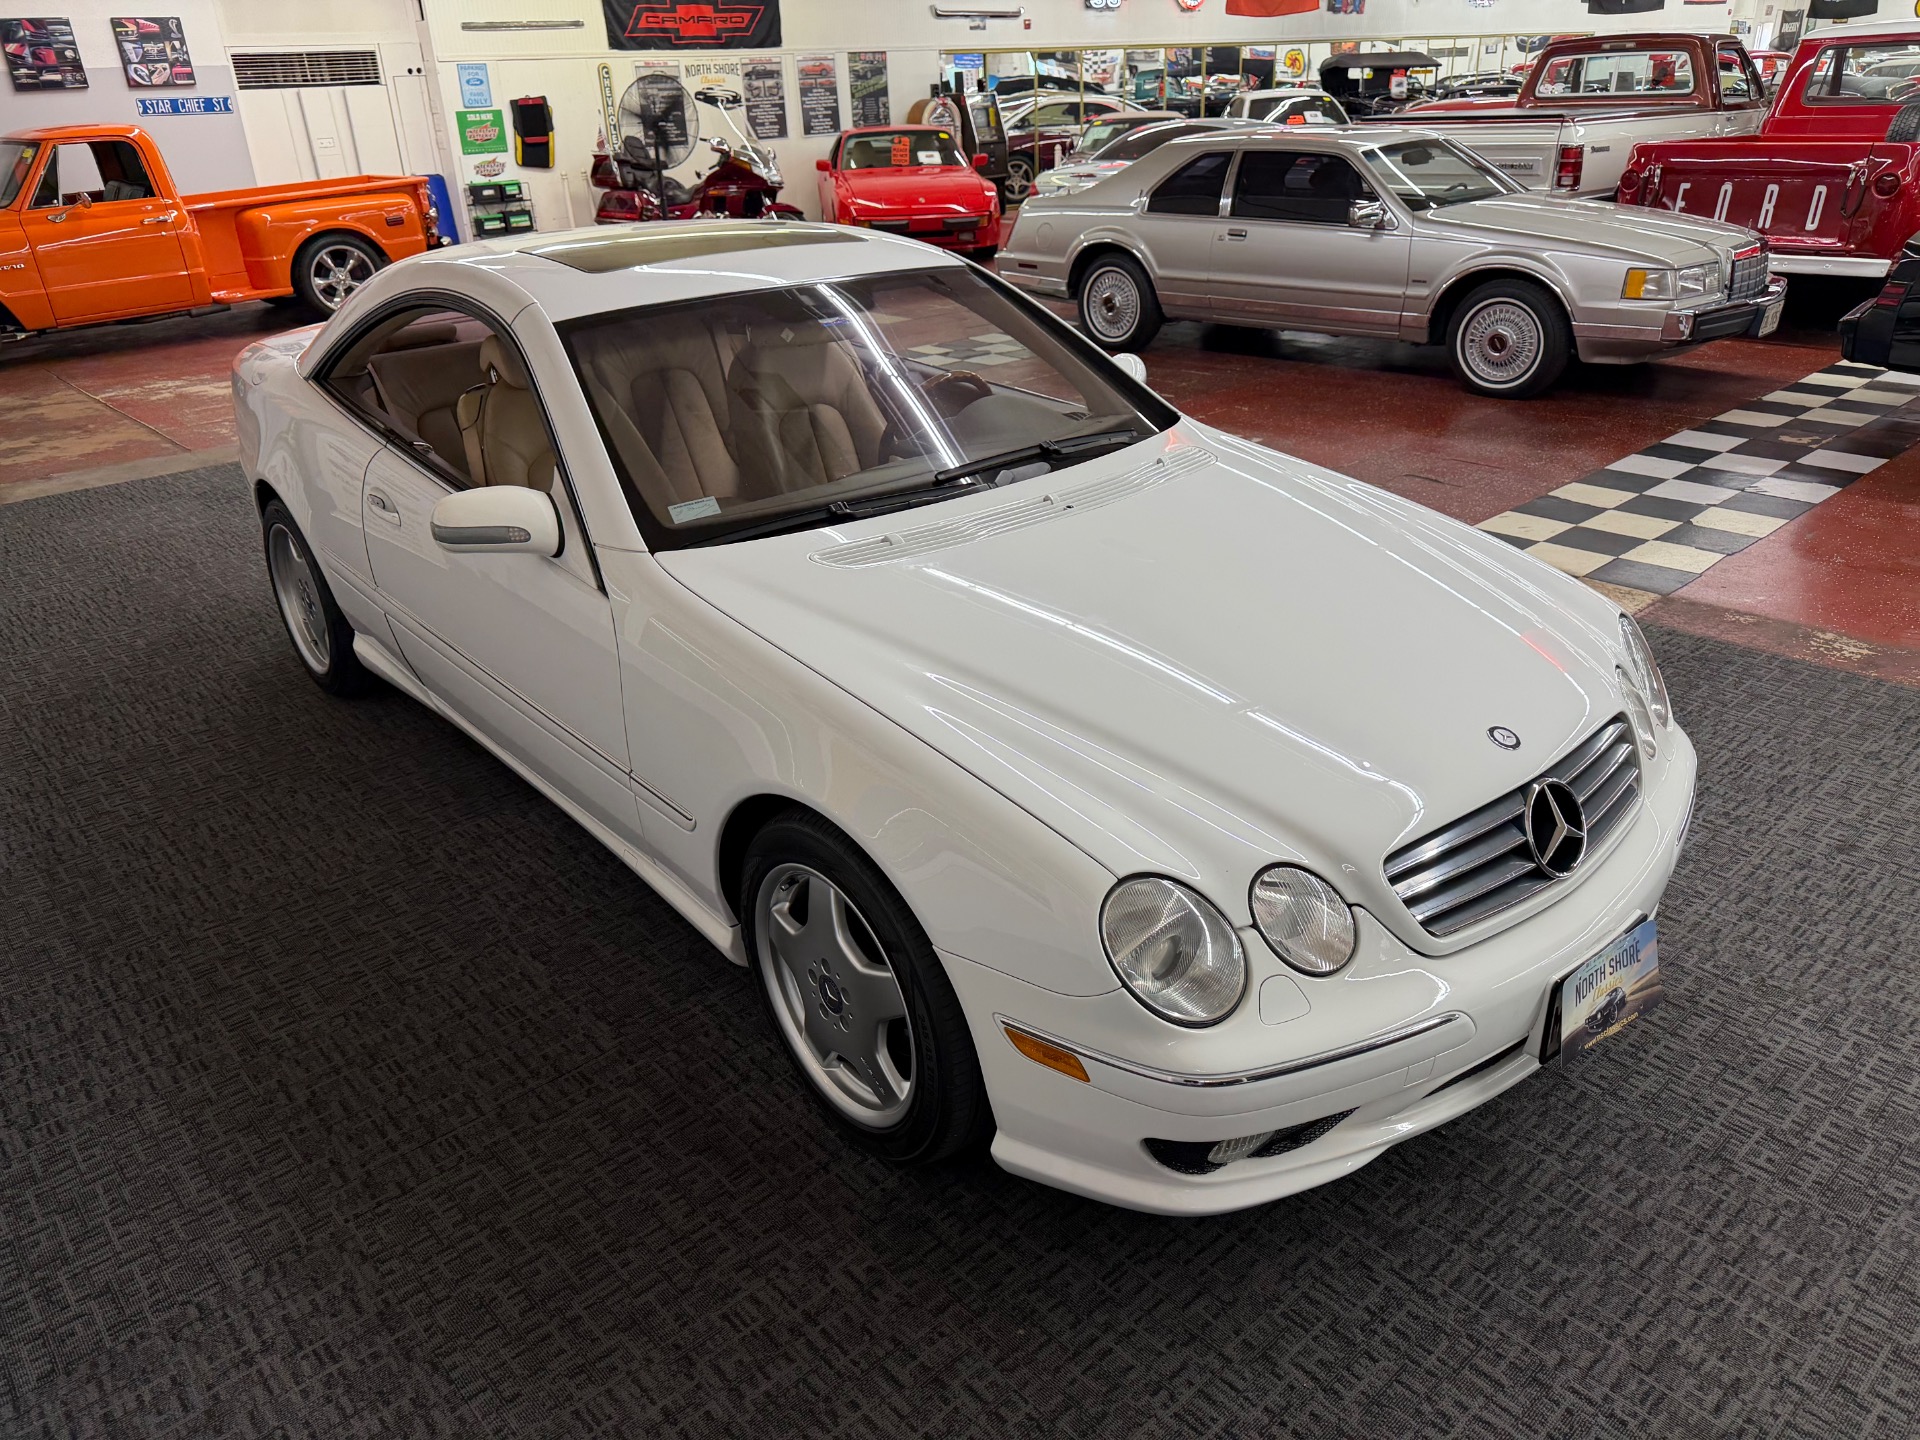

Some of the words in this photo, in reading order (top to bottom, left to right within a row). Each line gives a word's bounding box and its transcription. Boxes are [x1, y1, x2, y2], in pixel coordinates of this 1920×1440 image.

[645, 15, 745, 25] CAMARO
[684, 64, 711, 78] NORTH
[713, 62, 740, 76] SHORE
[145, 99, 173, 114] STAR
[178, 98, 205, 113] CHIEF
[212, 97, 225, 112] ST
[467, 97, 488, 105] ONLY
[602, 66, 620, 152] CHEVROLET
[1674, 182, 1827, 231] FORD
[1575, 964, 1606, 1007] NORTH
[1609, 940, 1641, 975] SHORE
[1593, 975, 1624, 1002] Classics
